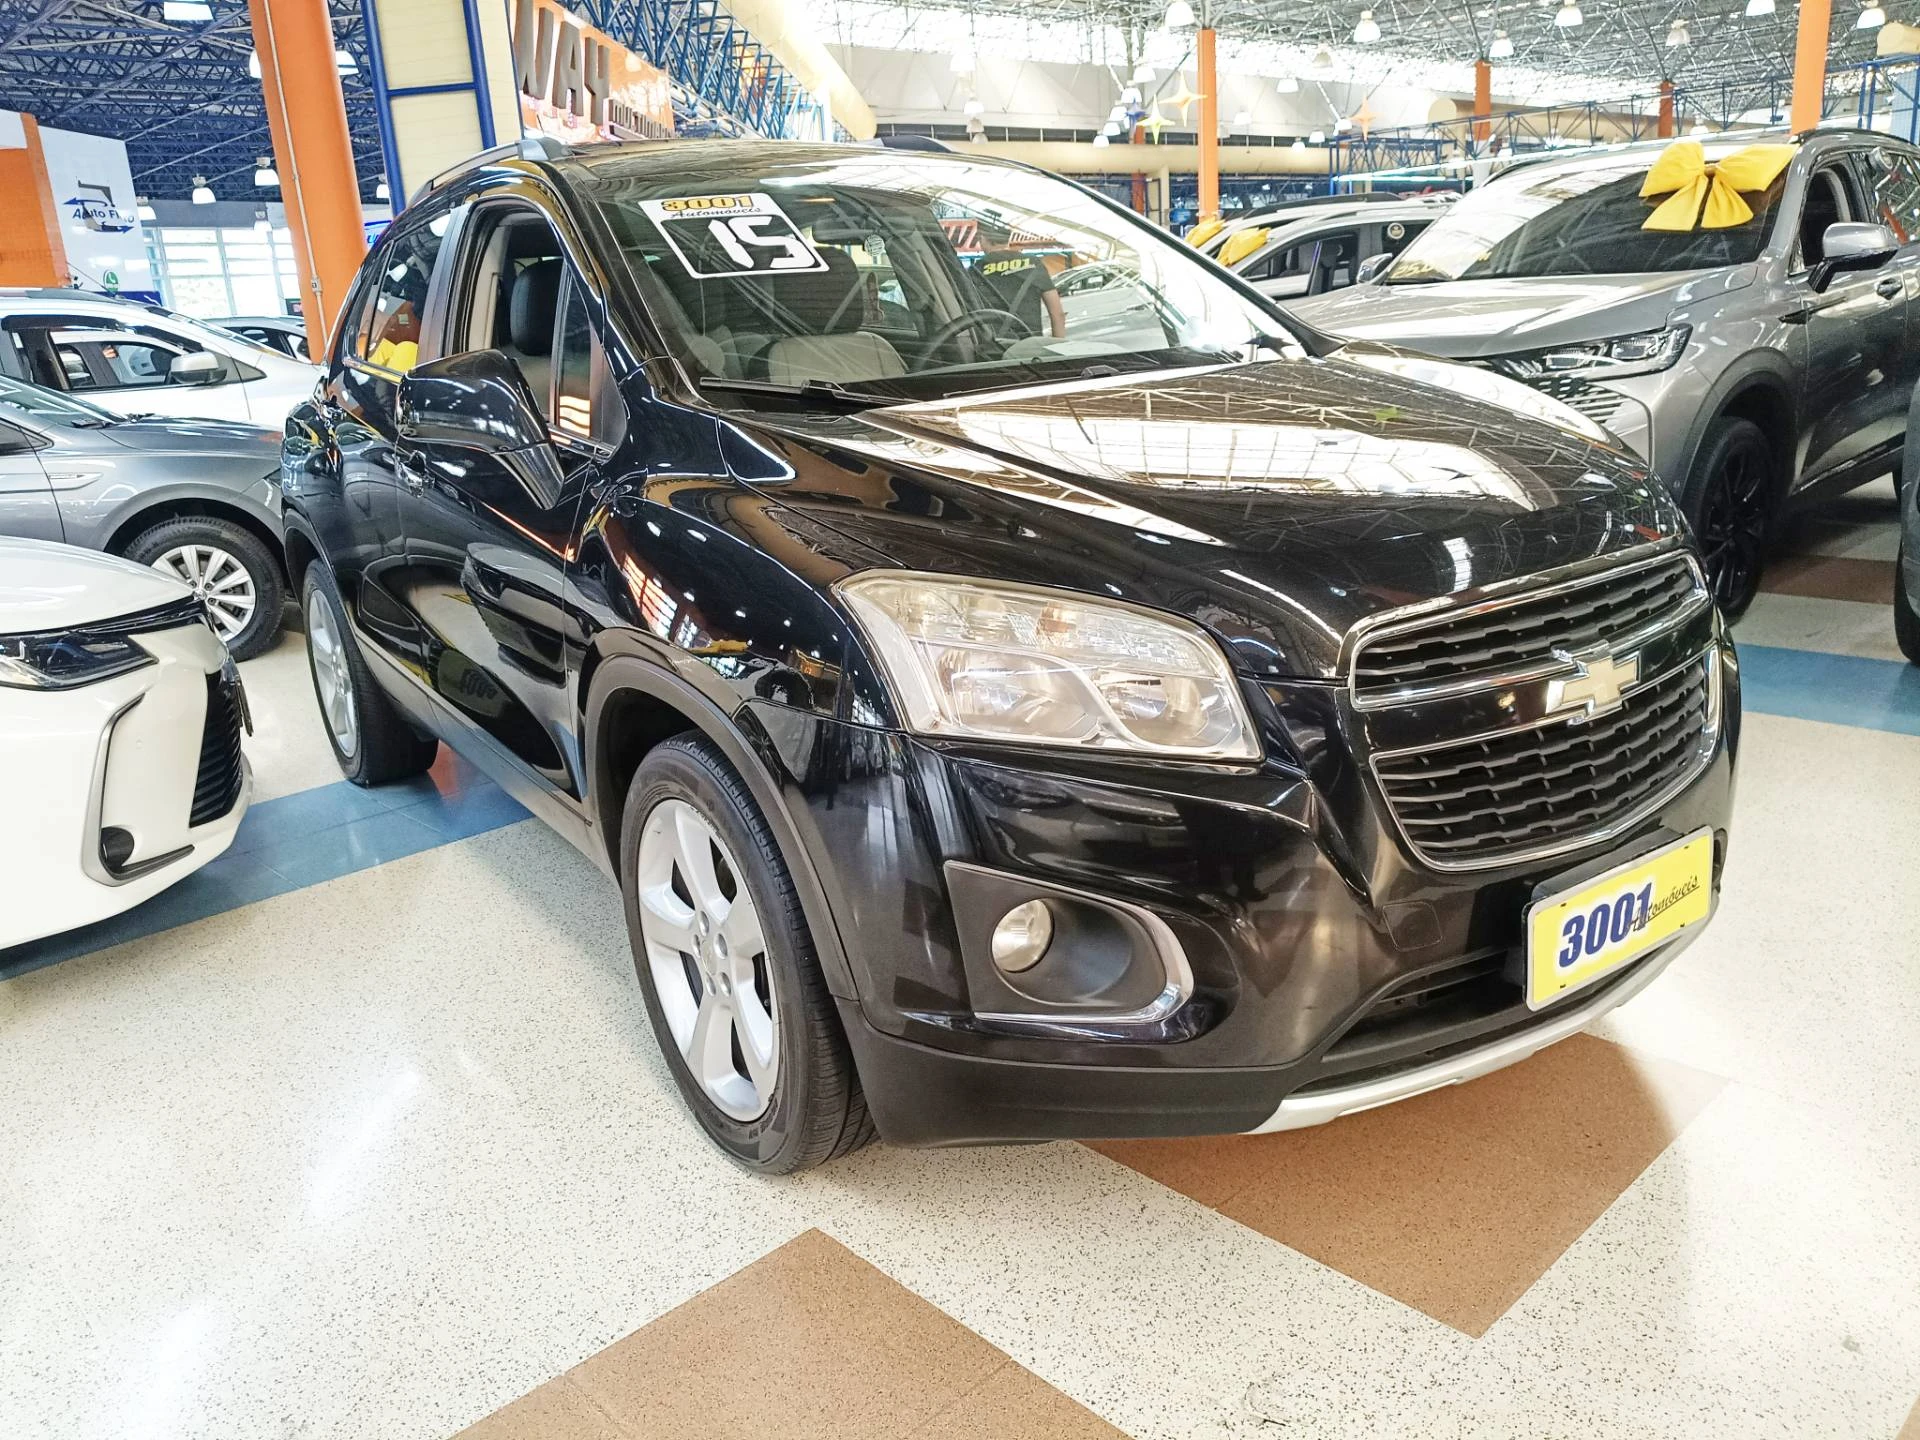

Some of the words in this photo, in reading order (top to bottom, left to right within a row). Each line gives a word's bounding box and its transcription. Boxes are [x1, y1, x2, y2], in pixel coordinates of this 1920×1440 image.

[661, 195, 754, 212] 3001
[708, 216, 815, 269] 15
[983, 258, 1030, 276] 3001
[1559, 882, 1652, 968] 3001
